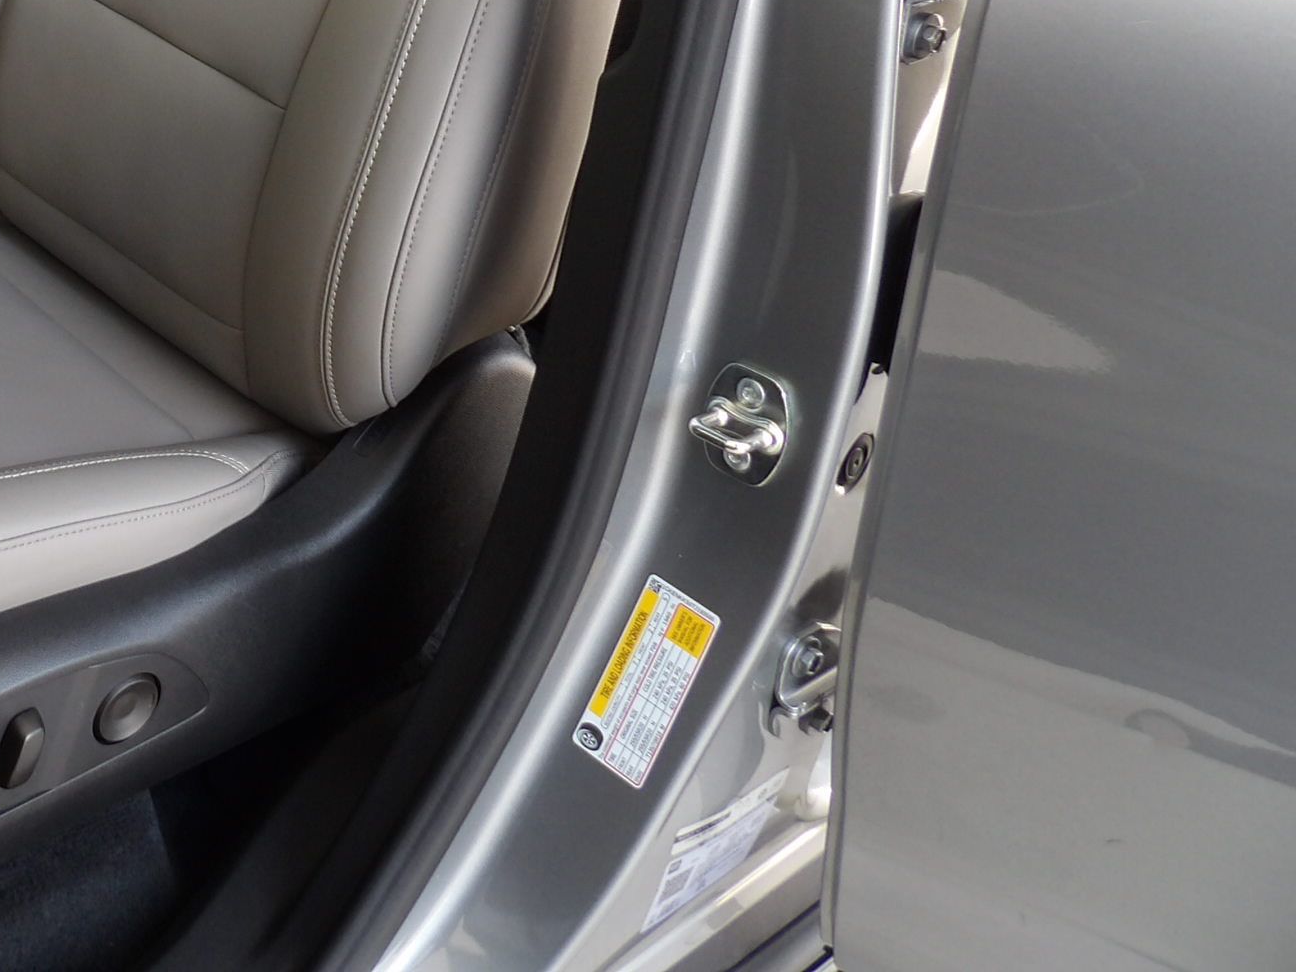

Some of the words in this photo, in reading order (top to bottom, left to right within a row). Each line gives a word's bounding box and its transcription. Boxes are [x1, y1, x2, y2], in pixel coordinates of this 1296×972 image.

[624, 609, 649, 650] INFORMATION
[612, 646, 631, 675] LOADING
[642, 679, 653, 694] COLD
[648, 669, 657, 682] TIRE
[653, 646, 668, 672] PRESSURE
[600, 684, 613, 700] TIRE
[605, 671, 619, 689] AND
